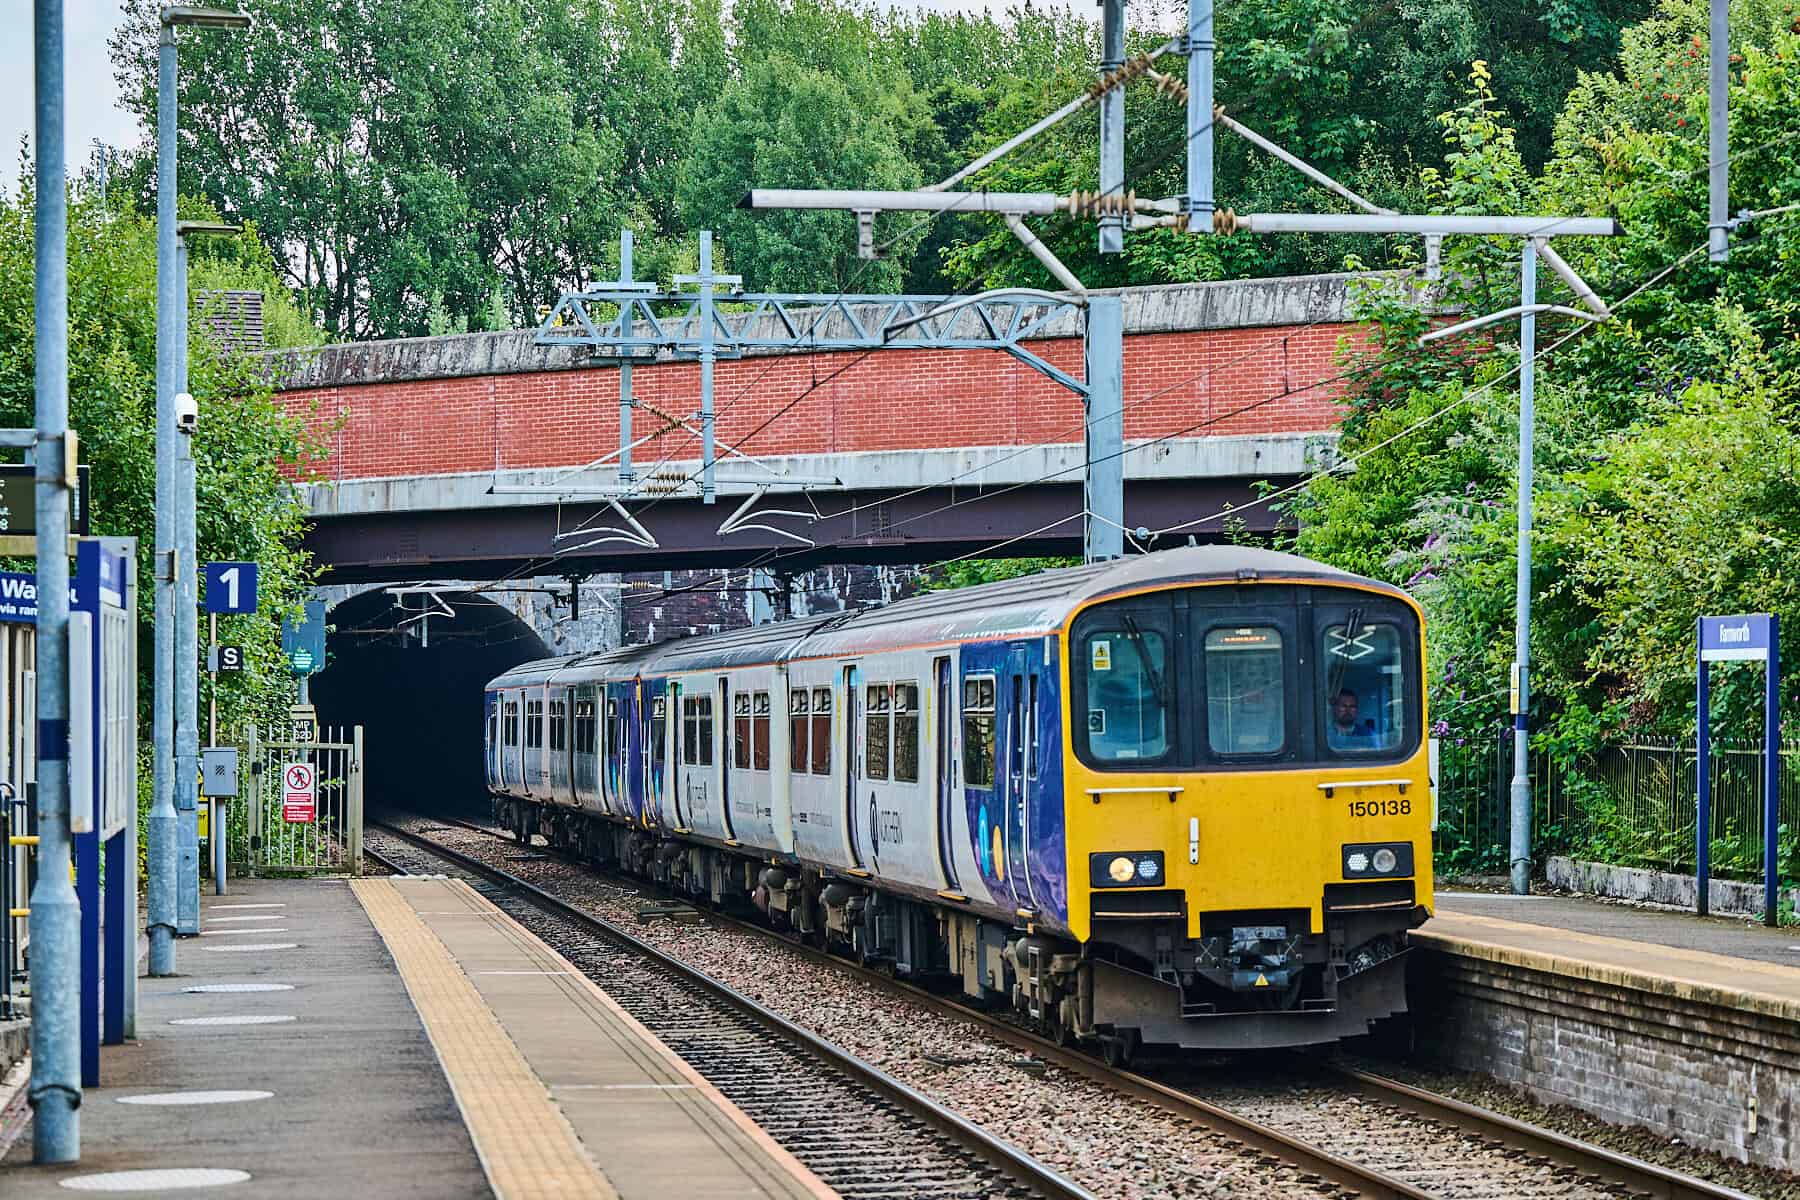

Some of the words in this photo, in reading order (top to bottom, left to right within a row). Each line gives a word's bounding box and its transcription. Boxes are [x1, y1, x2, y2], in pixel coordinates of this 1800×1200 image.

[1, 578, 38, 605] Wa
[219, 567, 239, 608] 1
[223, 647, 238, 665] S
[1348, 799, 1412, 817] 150138
